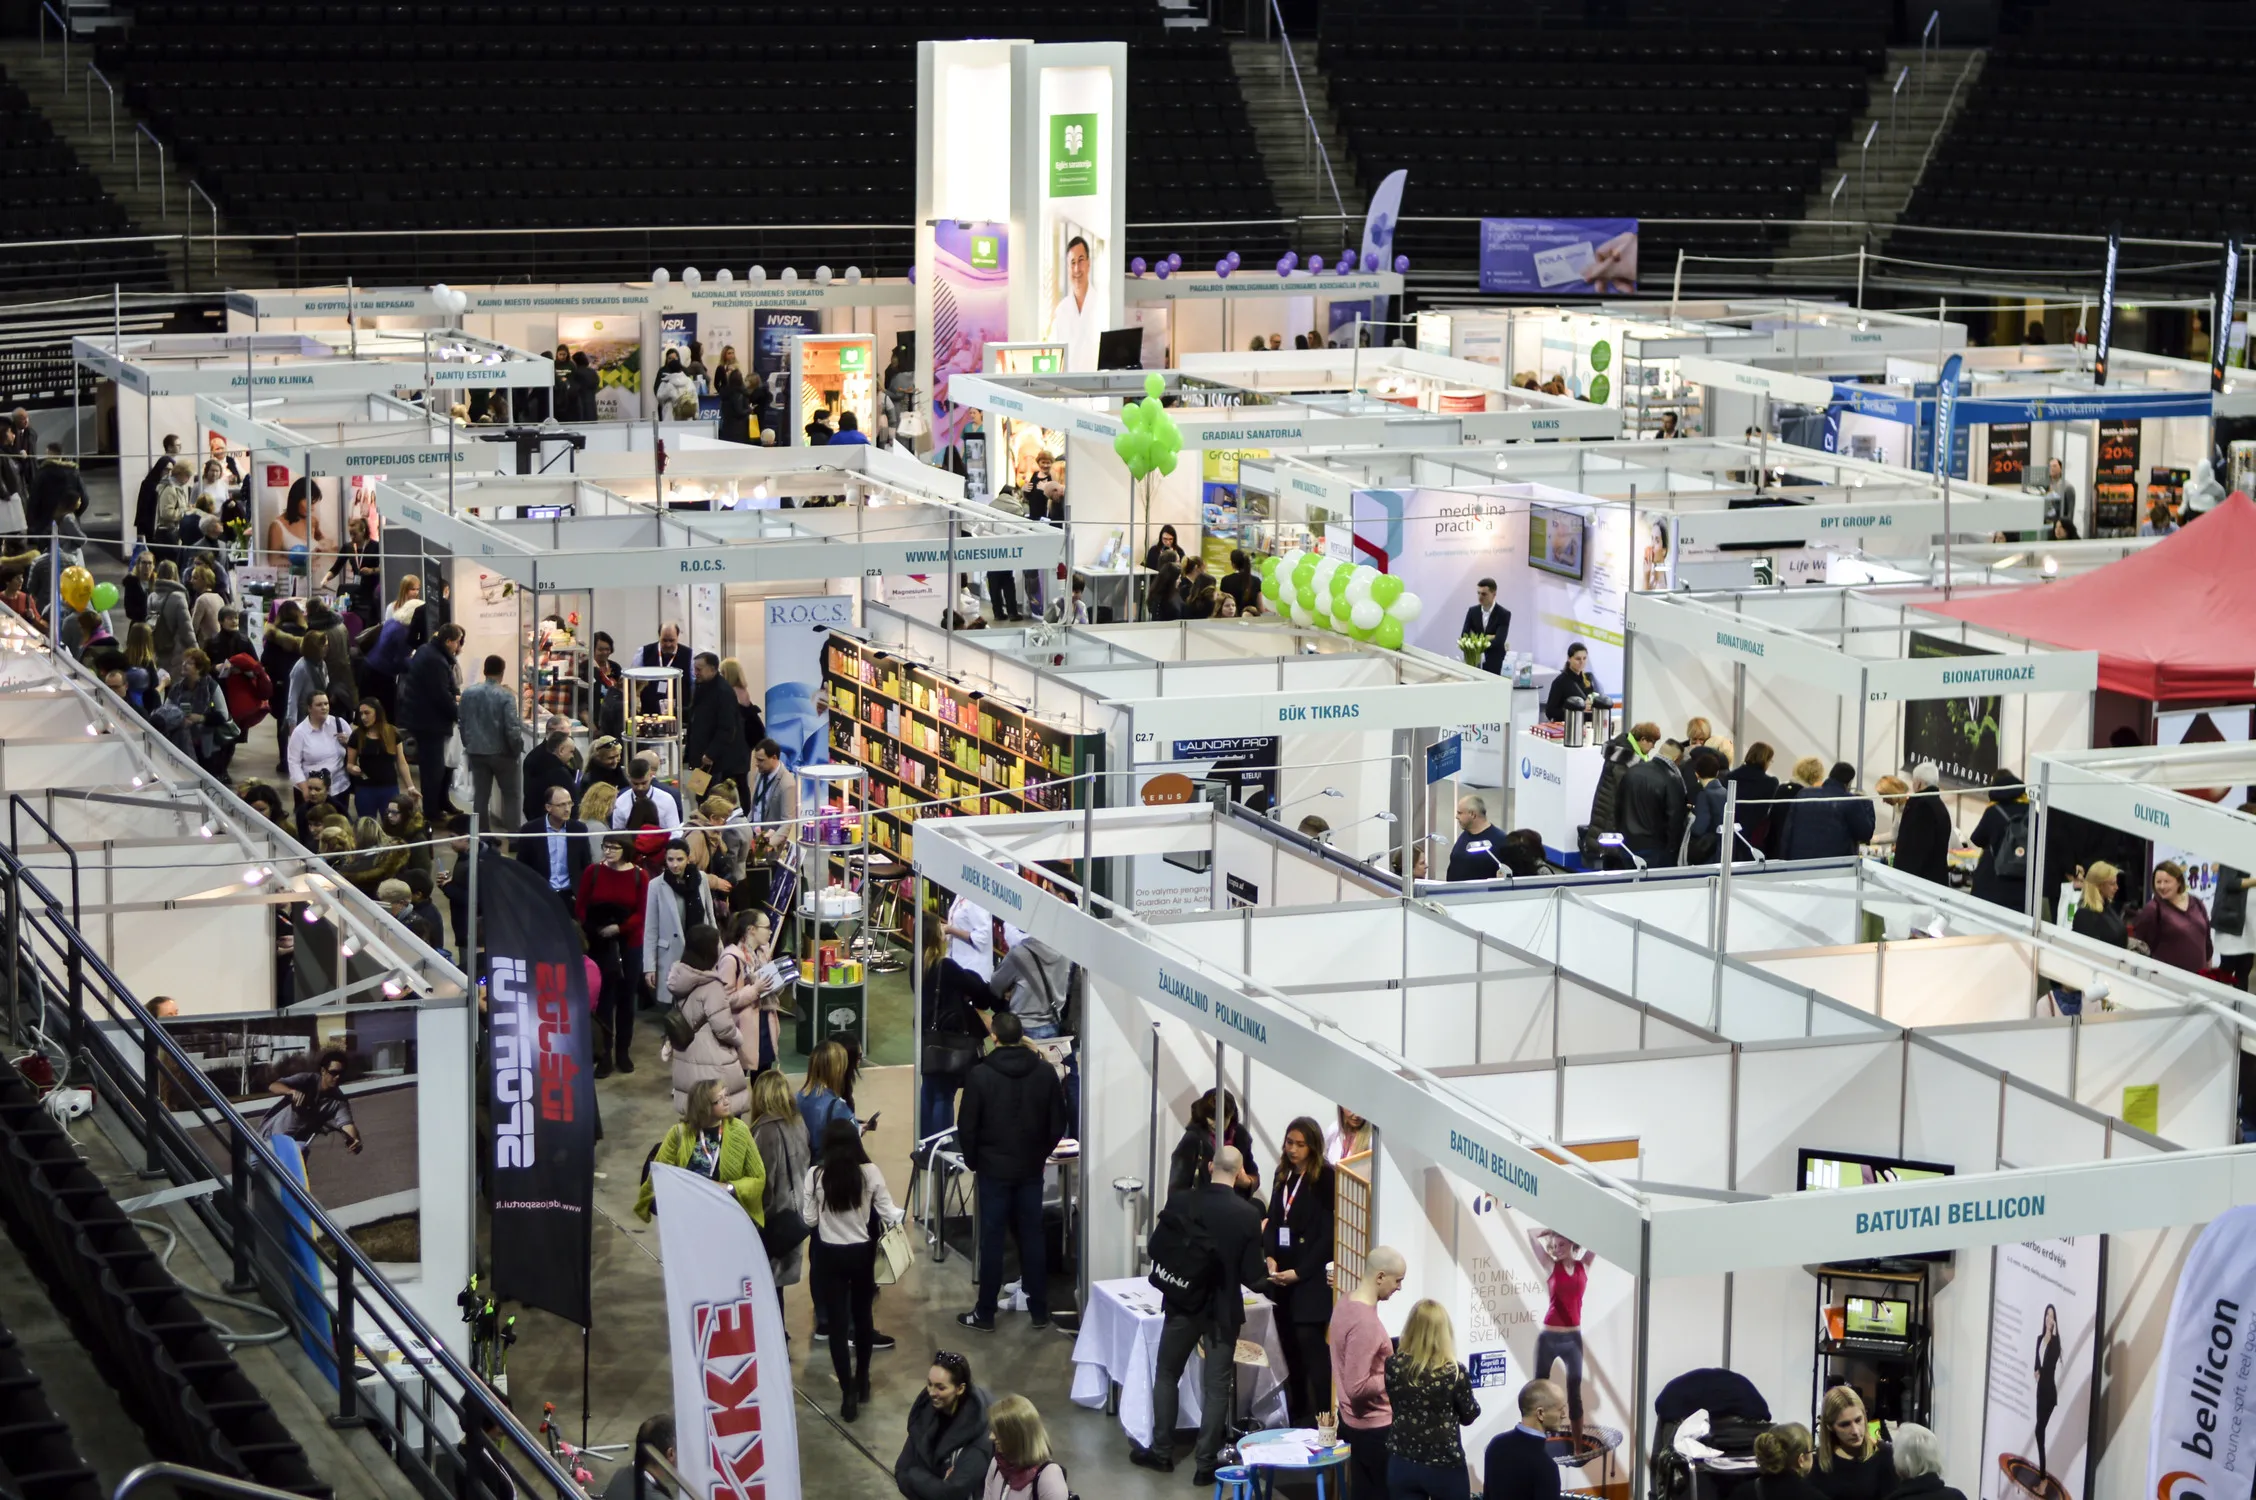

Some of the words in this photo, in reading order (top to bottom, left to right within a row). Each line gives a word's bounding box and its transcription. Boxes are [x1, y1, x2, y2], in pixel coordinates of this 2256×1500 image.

[786, 289, 825, 297] SVEIKATOS
[581, 297, 621, 305] SVEIKATOS
[622, 296, 649, 304] BIURAS
[755, 298, 808, 307] LABORATORIJA
[767, 315, 805, 327] NVSPL
[278, 376, 314, 384] KLINIKA
[436, 371, 464, 381] DANTŲ
[466, 370, 507, 379] ESTETIKA
[1532, 420, 1560, 430] VAIKIS
[1202, 430, 1244, 441] GRADIALI
[1246, 428, 1302, 439] SANATORIJA
[2104, 446, 2134, 460] 20%
[346, 454, 416, 467] ORTOPEDIJOS
[1994, 460, 2024, 473] 20%
[1820, 517, 1839, 528] BPT
[1842, 516, 1876, 527] GROUP
[1878, 515, 1892, 526] AG
[905, 546, 1024, 564] WWW.MAGNESIUM.LT
[680, 560, 726, 573] R.O.C.S.
[866, 569, 883, 577] C2.5
[1790, 561, 1809, 572] Life
[770, 602, 848, 625] R.O.C.S.
[1716, 632, 1765, 657] BIONATUROAZĖ
[1942, 664, 2036, 684] BIONATUROAZĖ
[1870, 692, 1887, 701] C1.7
[1279, 705, 1307, 721] BŪK
[1311, 704, 1360, 720] TIKRAS
[1135, 733, 1155, 742] C2.7
[1178, 739, 1240, 751] LAUNDRY
[1532, 765, 1543, 778] USP
[1544, 770, 1562, 786] Baltics
[1141, 794, 1182, 802] AERUS
[2134, 804, 2171, 829] OLIVETA
[961, 865, 981, 888] JUDĖK
[982, 878, 991, 893] BE
[992, 882, 1023, 912] SKAUSMO
[1136, 888, 1150, 897] Oro
[1151, 886, 1179, 898] valymo
[1136, 897, 1171, 907] Guardian
[1172, 897, 1183, 905] Air
[1158, 968, 1208, 1013] ŽALIAKALNIO
[1216, 1000, 1267, 1044] POLIKLINIKA
[1450, 1130, 1489, 1169] BATUTAI
[1492, 1152, 1538, 1197] BELLICON
[1856, 1206, 1941, 1234] BATUTAI
[1948, 1196, 2045, 1225] BELLICON
[1472, 1256, 1491, 1269] TIK
[2042, 1248, 2067, 1269] erdvėje
[1473, 1272, 1486, 1285] 10
[1490, 1268, 1518, 1283] MIN.
[1471, 1285, 1496, 1299] PER
[1470, 1300, 1497, 1315] KAD
[1470, 1310, 1538, 1329] IŠLIKTUME
[1470, 1328, 1510, 1344] SVEIKI
[2181, 1298, 2240, 1460] bellicon
[2224, 1416, 2243, 1472] bounce
[2236, 1352, 2252, 1384] feel
